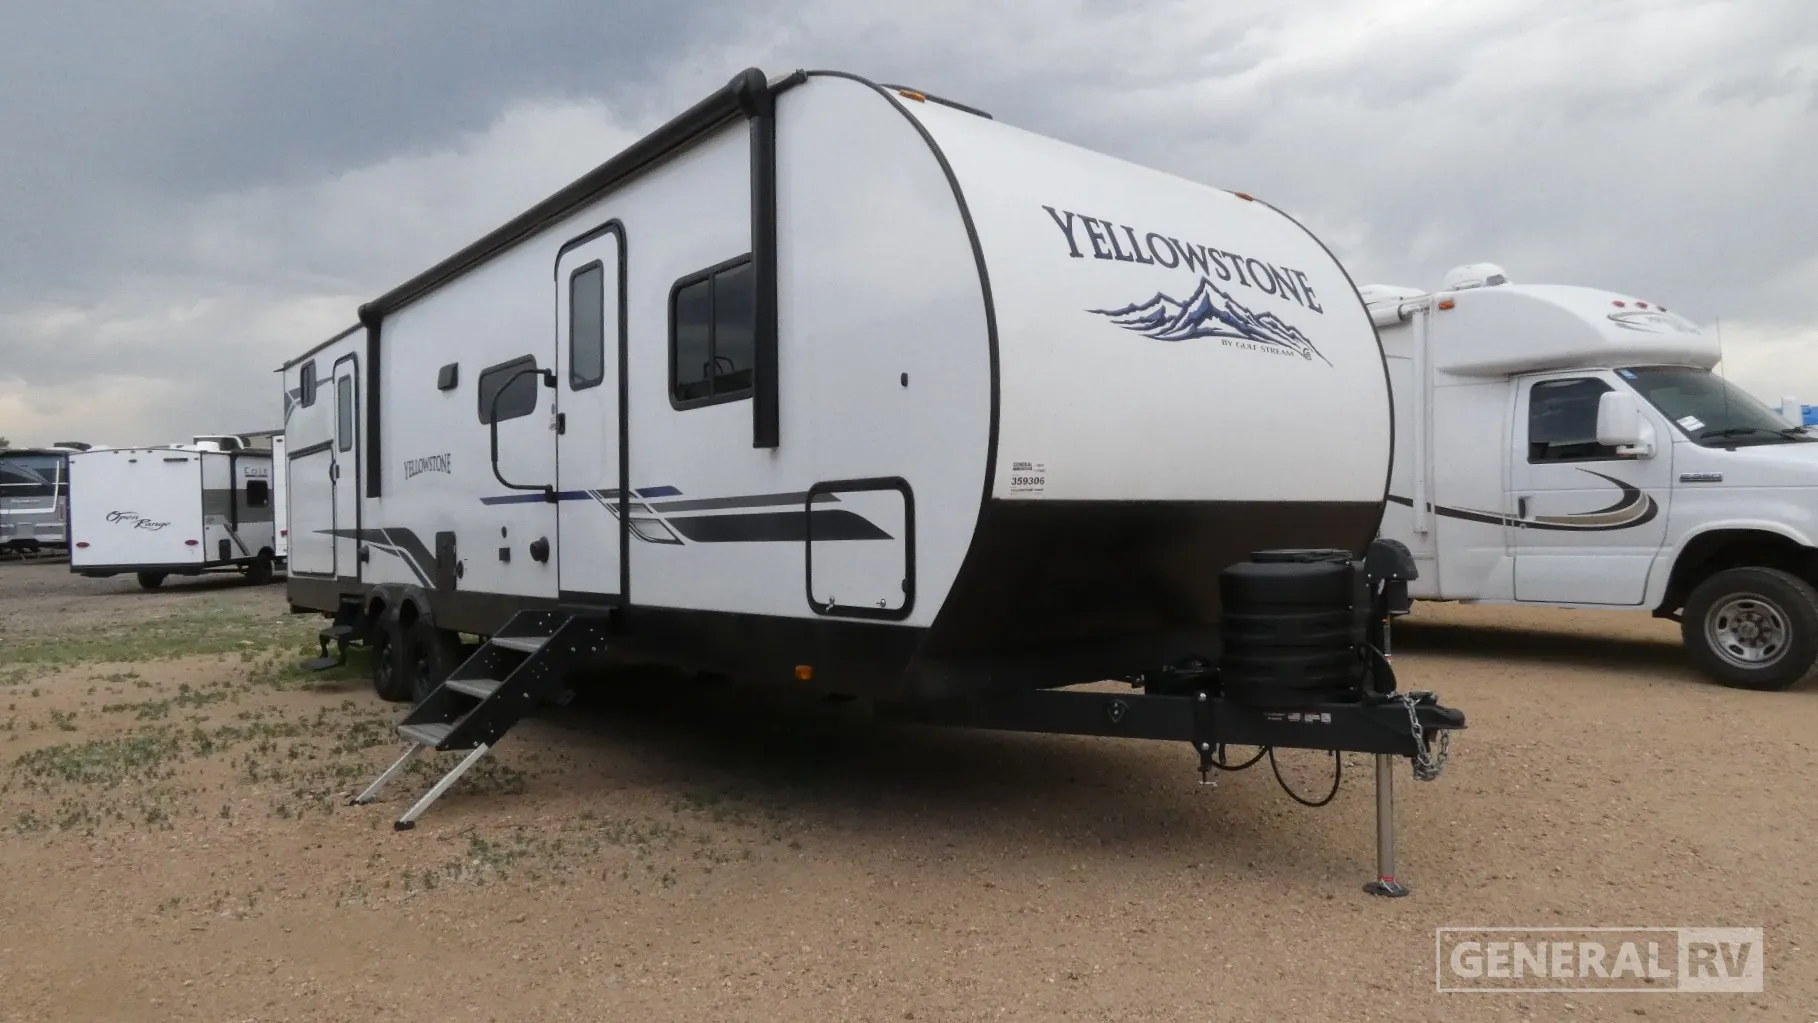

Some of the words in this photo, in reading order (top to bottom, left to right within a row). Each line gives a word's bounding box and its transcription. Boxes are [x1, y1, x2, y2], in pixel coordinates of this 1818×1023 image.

[1041, 204, 1324, 314] YELLOWSTONE
[1221, 339, 1233, 347] BY
[1235, 341, 1258, 351] GULF
[1260, 345, 1295, 357] STREAM
[403, 453, 451, 480] YELLOWSTONE
[1011, 476, 1045, 486] 359306
[105, 510, 140, 524] Open
[132, 518, 171, 531] Range
